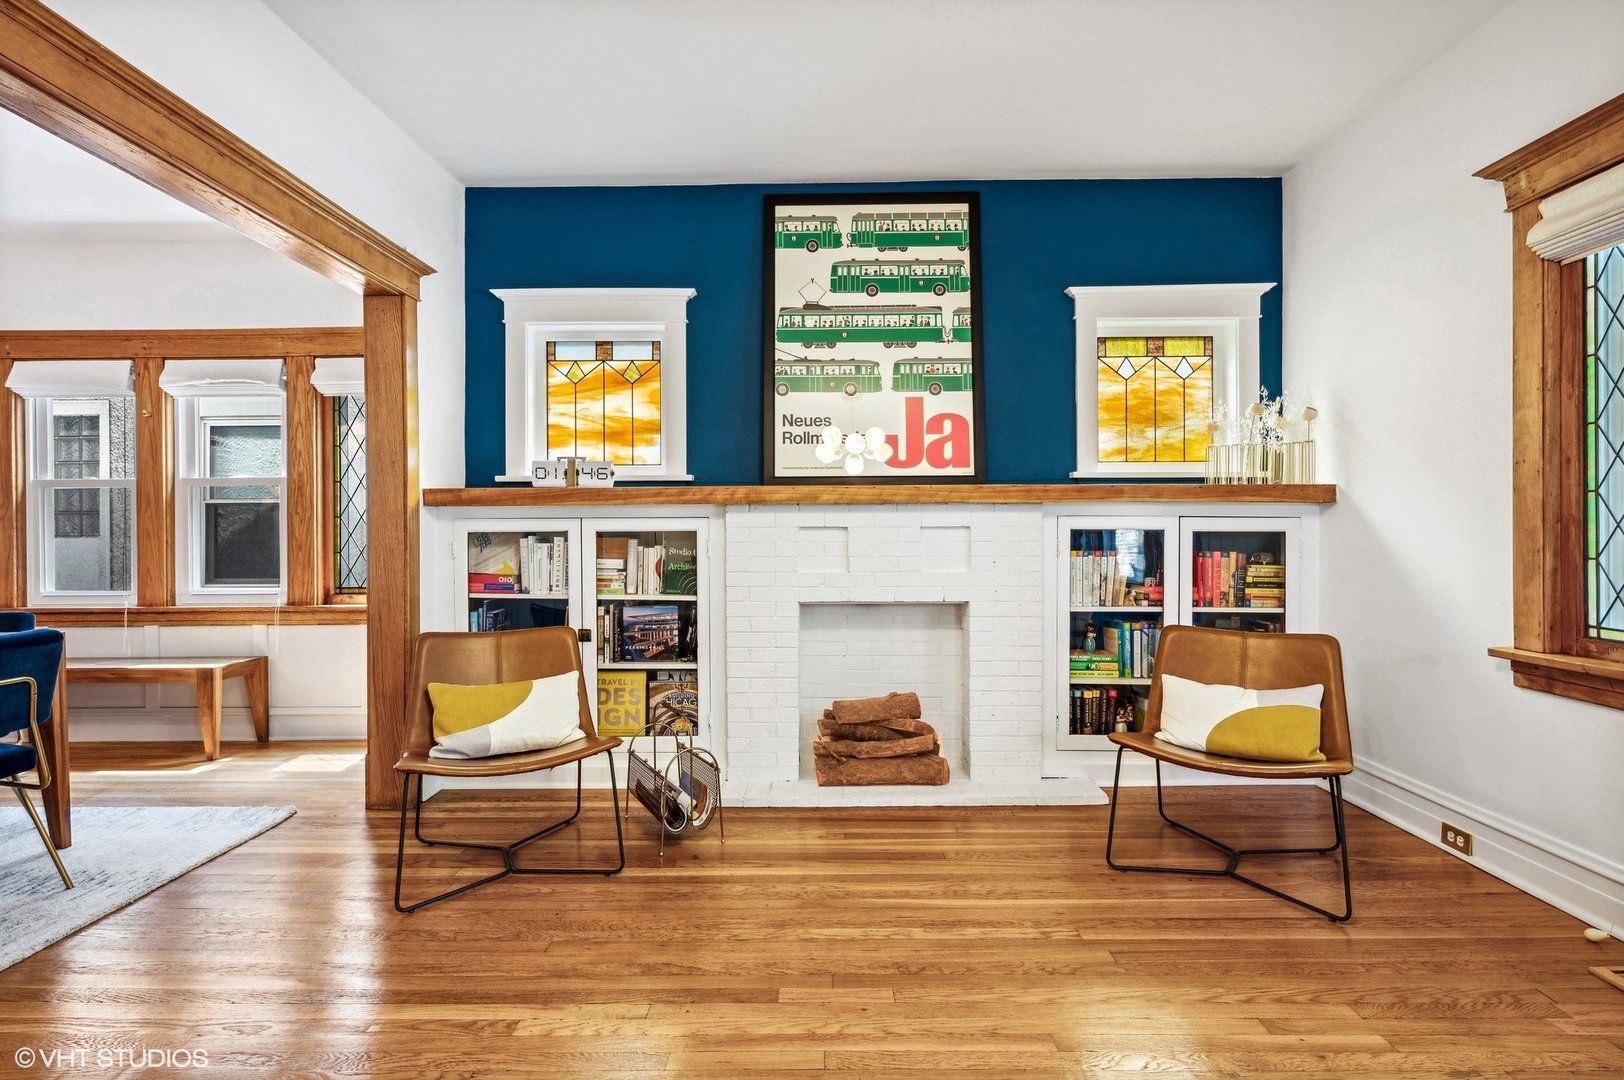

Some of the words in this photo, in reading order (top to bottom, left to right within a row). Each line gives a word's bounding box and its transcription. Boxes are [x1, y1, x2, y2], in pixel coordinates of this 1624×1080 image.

[782, 413, 832, 427] Neues
[884, 396, 971, 470] Ja
[668, 547, 692, 556] Studio
[597, 678, 628, 686] TRAVEL
[630, 678, 641, 686] BY
[597, 687, 642, 705] DES
[665, 698, 697, 707] HICAG
